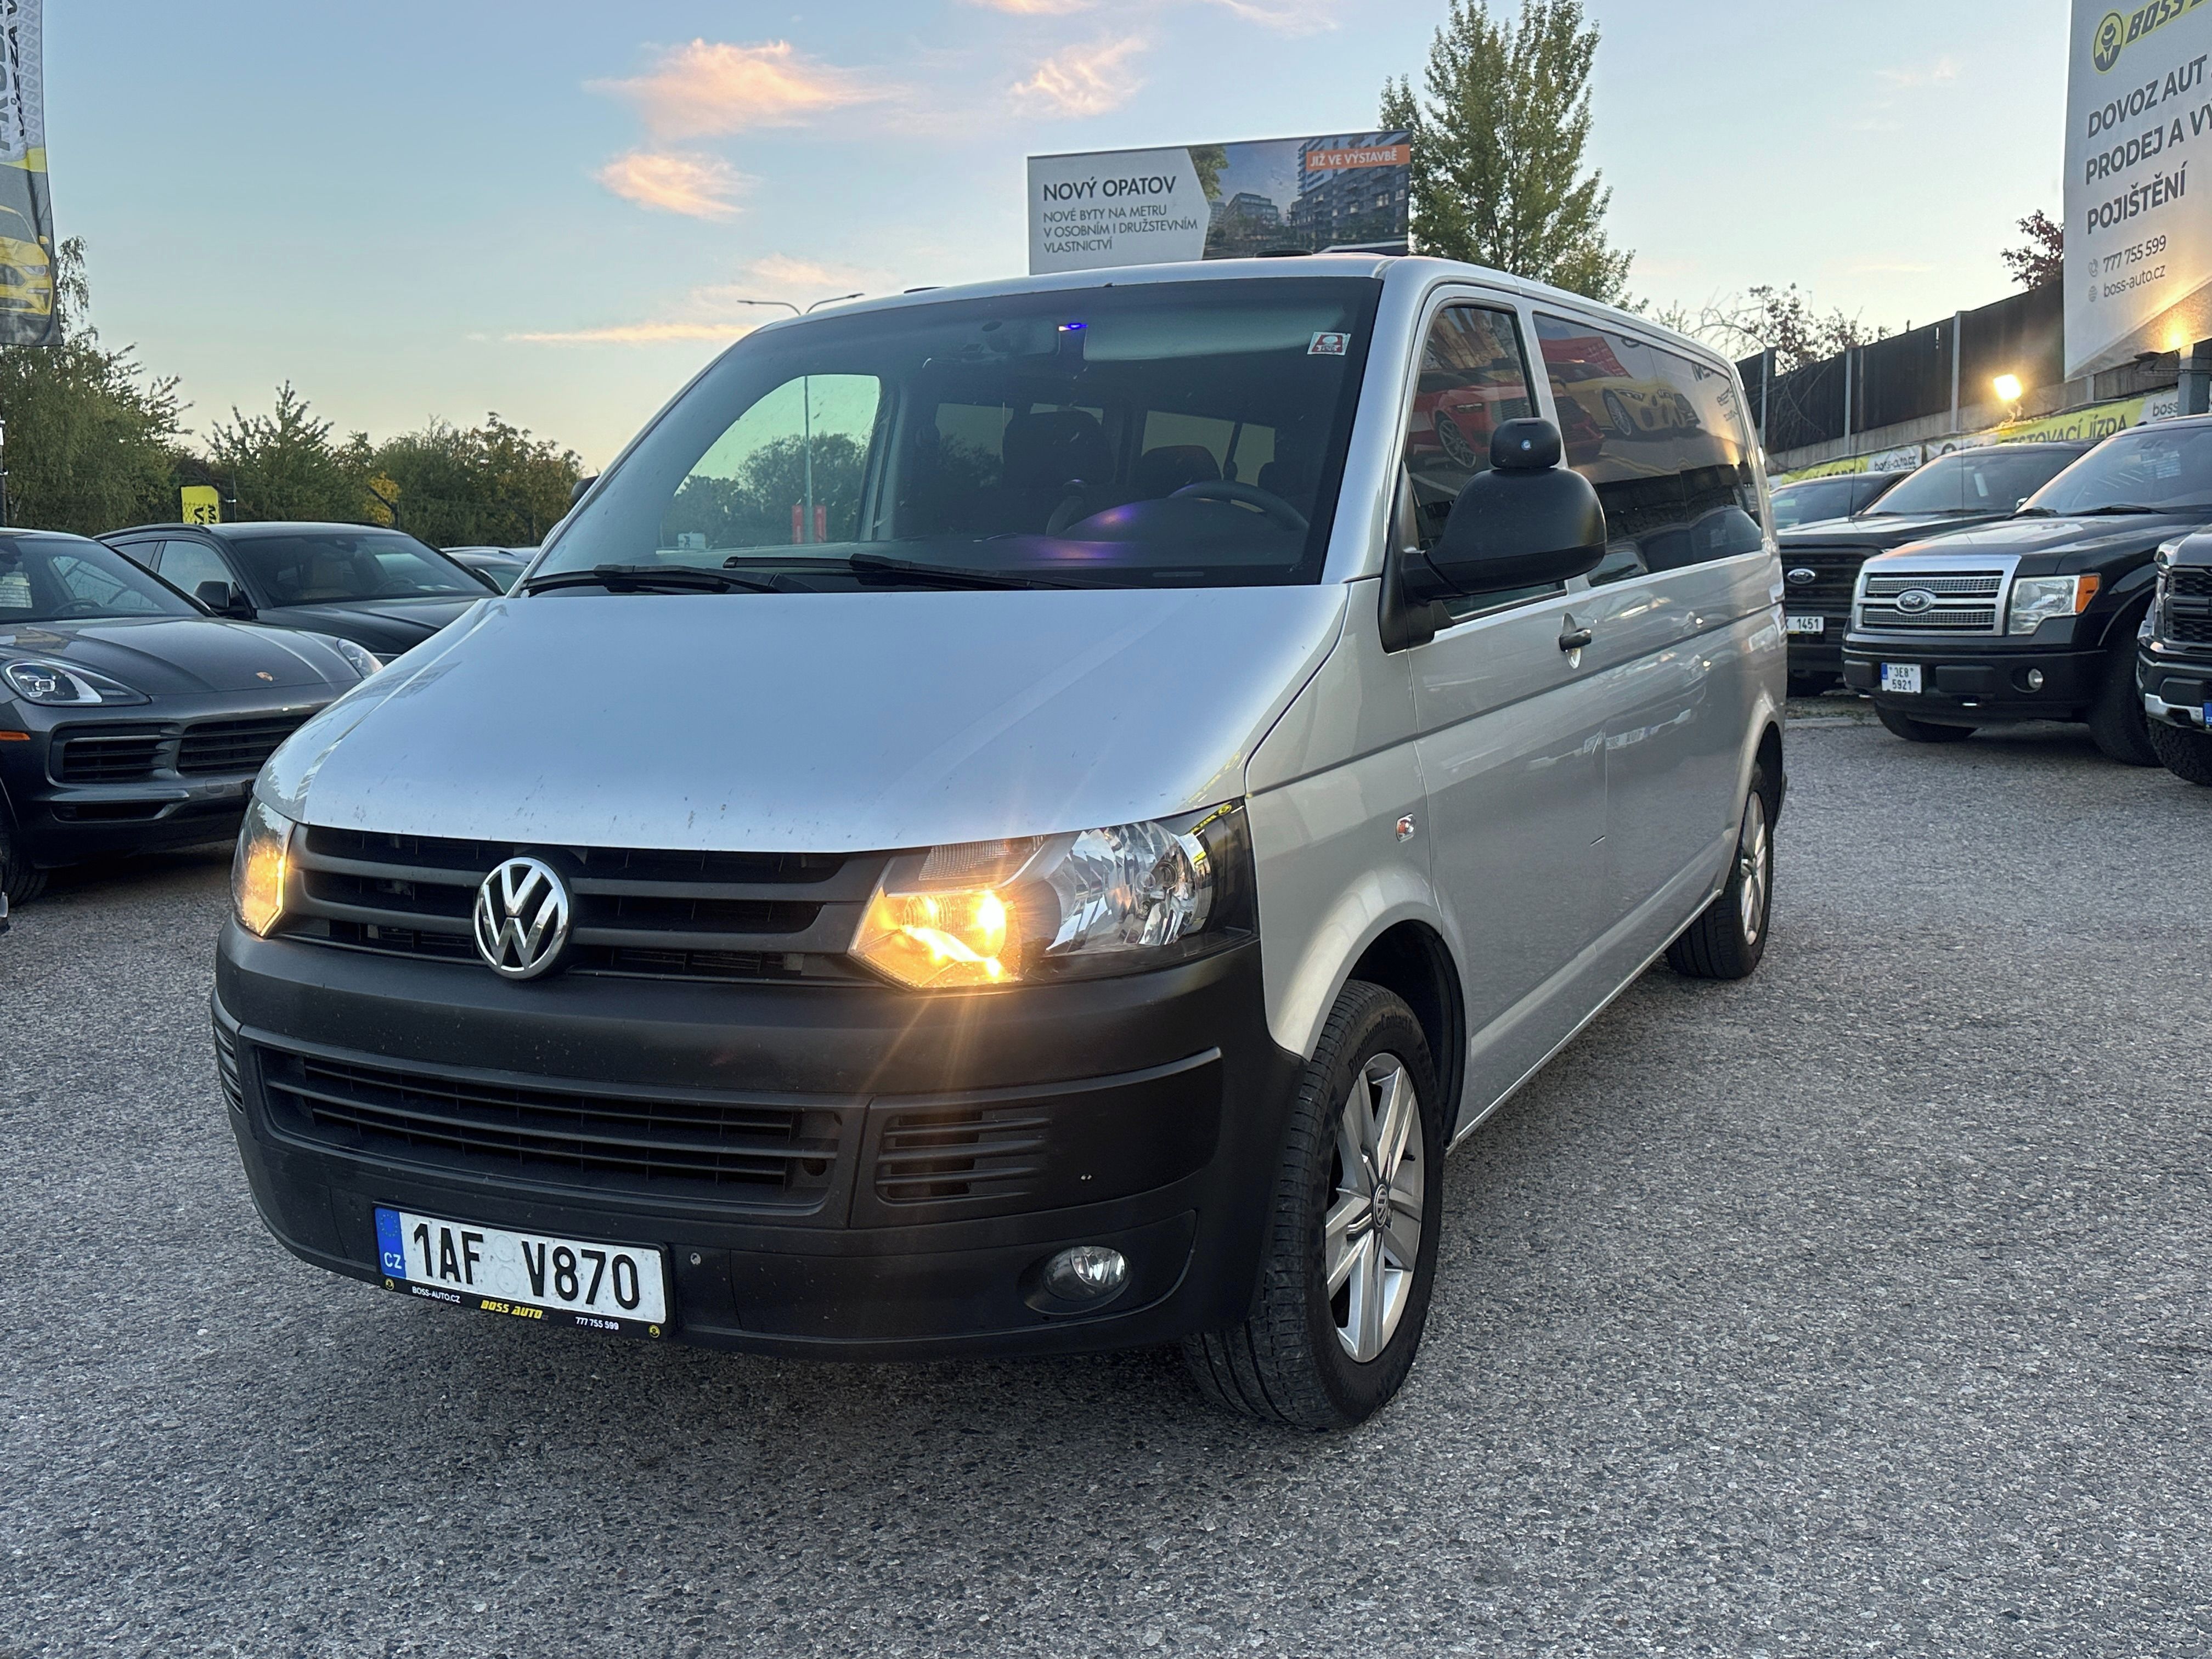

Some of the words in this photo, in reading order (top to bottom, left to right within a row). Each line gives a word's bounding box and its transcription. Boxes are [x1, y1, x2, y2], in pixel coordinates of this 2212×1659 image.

[2088, 80, 2158, 138] DOVOZ
[2162, 54, 2208, 102] AUT
[1310, 153, 1325, 167] JIŽ
[1328, 154, 1342, 165] VE
[1344, 148, 1397, 163] VÝSTAVBĚ
[2086, 125, 2163, 185] PRODEJ
[2168, 117, 2185, 148] A
[1043, 176, 1097, 201] NOVÝ
[1103, 176, 1177, 198] OPATOV
[2087, 160, 2188, 235] POJIŠTĚNÍ
[1043, 207, 1077, 223] NOVÉ
[1080, 208, 1105, 221] BYTY
[1108, 207, 1127, 219] NA
[1130, 204, 1167, 218] METRU
[1043, 228, 1052, 238] V
[1054, 222, 1110, 238] OSOBNÍM
[1113, 223, 1116, 234] I
[1119, 216, 1198, 234] DRUŽSTEVNÍM
[1043, 236, 1113, 253] VLASTNICTVÍ
[2103, 252, 2122, 273] 777
[2124, 244, 2143, 265] 755
[2145, 235, 2166, 257] 599
[2103, 264, 2166, 297] boss-auto.cz
[2084, 415, 2127, 439] JÍZDA
[1797, 618, 1819, 630] 1451
[1894, 667, 1909, 678] 3E8
[1892, 679, 1912, 691] 5921
[383, 1252, 402, 1270] CZ
[413, 1222, 484, 1285] 1AF
[521, 1240, 640, 1310] V870
[411, 1286, 461, 1304] BOSS-AUTO.CZ
[480, 1300, 510, 1313] BOSS
[511, 1305, 544, 1319] AUTO
[575, 1317, 589, 1325] 777
[589, 1318, 604, 1328] 755
[605, 1320, 619, 1330] 599
